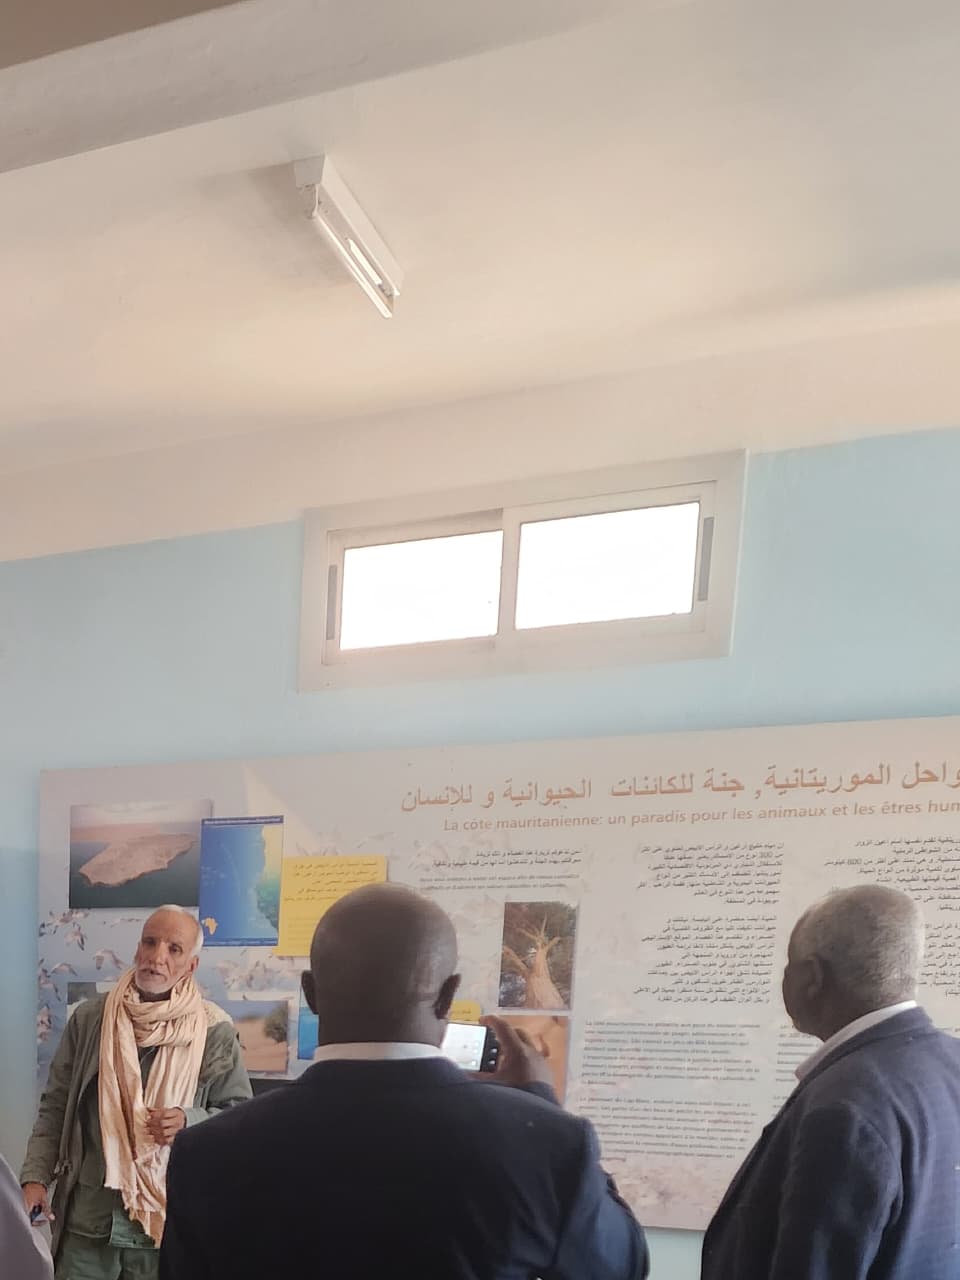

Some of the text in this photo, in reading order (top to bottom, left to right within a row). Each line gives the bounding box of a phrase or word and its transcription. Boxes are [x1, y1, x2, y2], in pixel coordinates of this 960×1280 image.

[502, 777, 592, 808] الحيوانية
[703, 767, 745, 797] جنة
[480, 790, 495, 808] و
[443, 819, 458, 831] La
[496, 814, 603, 829] mauritanienne:
[608, 815, 626, 825] un
[632, 809, 686, 826] paradis
[691, 810, 726, 824] pour
[732, 808, 753, 820] les
[758, 805, 827, 819] animaux
[832, 804, 848, 816] et
[854, 802, 876, 815] les
[882, 800, 921, 814] êtres
